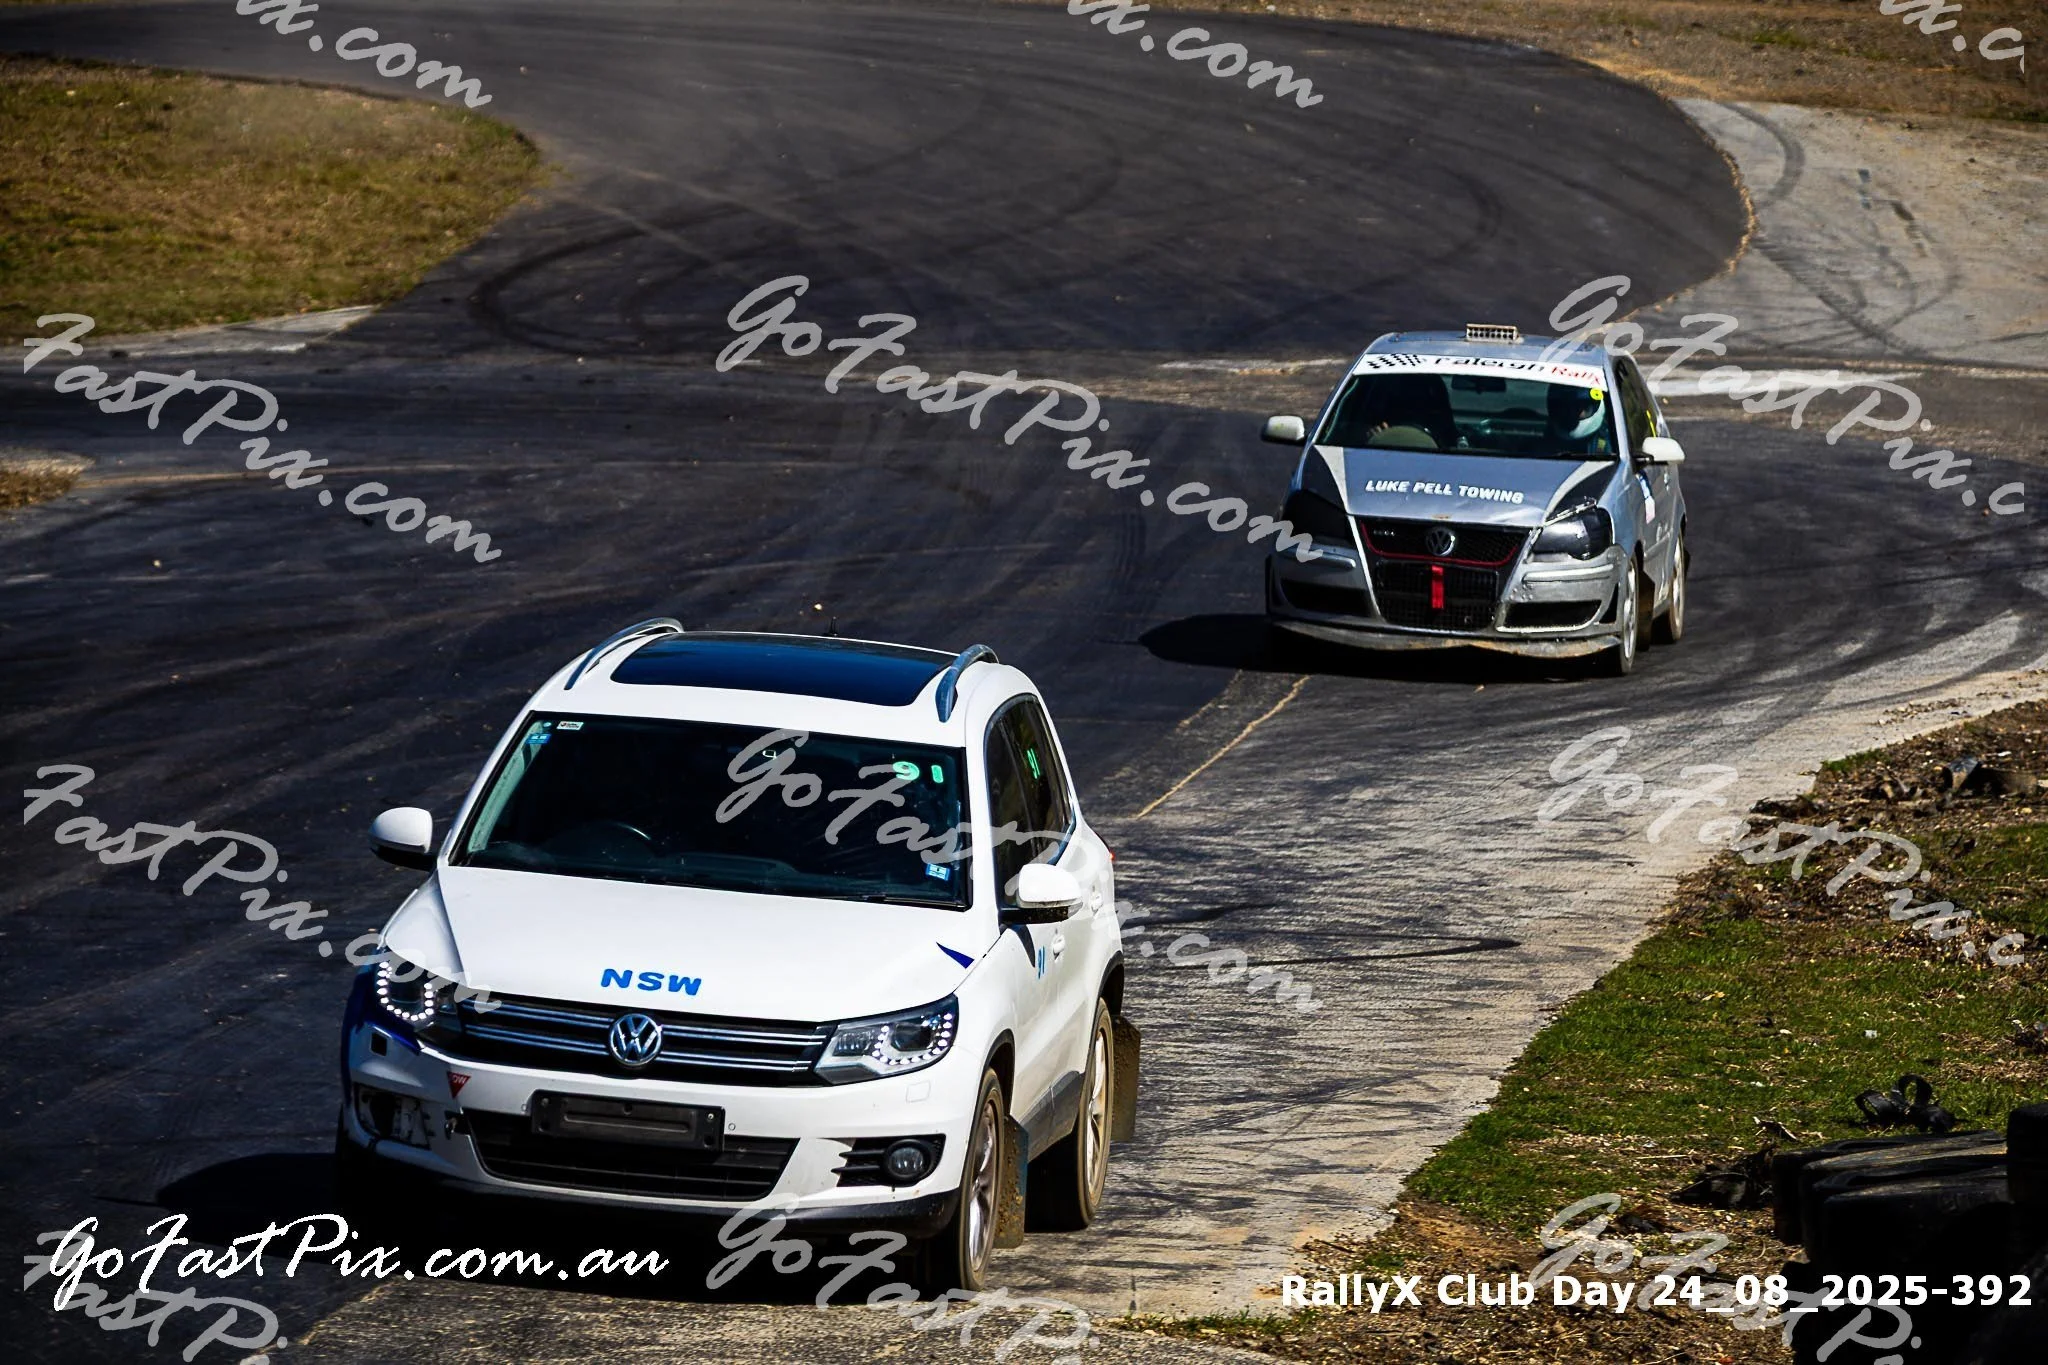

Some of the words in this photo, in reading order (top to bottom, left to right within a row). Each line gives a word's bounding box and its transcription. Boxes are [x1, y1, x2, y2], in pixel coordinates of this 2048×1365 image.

[1365, 480, 1410, 493] LUKE
[1412, 482, 1453, 496] PELL
[1459, 485, 1524, 504] TOWING
[892, 761, 944, 783] 91
[601, 968, 702, 996] NSW
